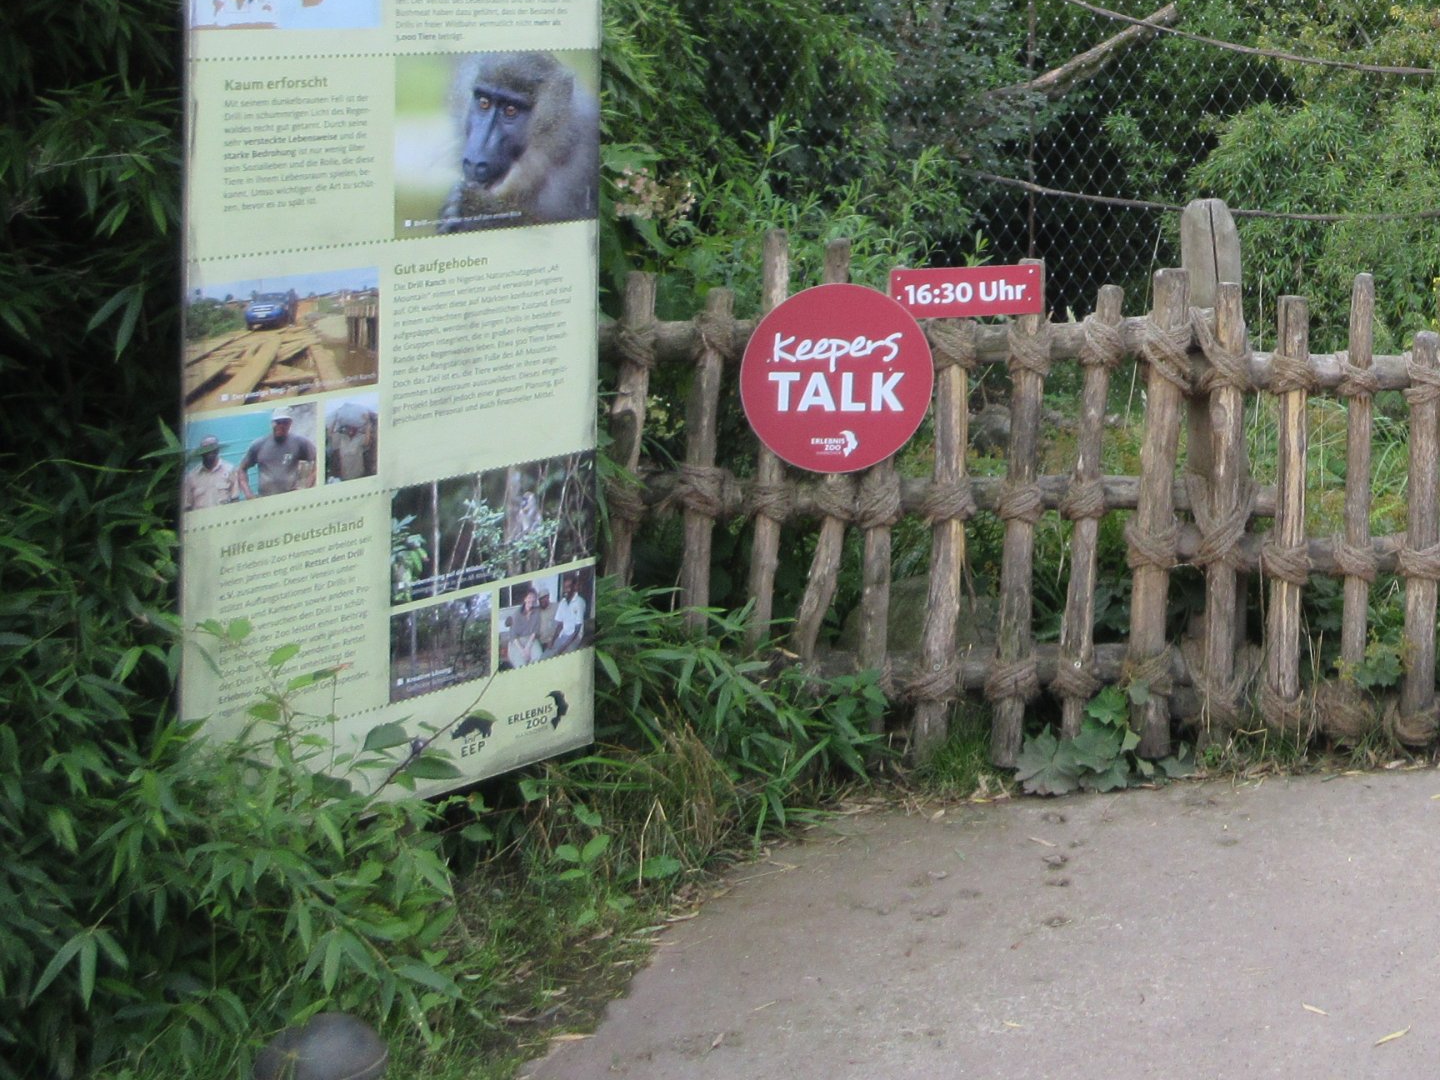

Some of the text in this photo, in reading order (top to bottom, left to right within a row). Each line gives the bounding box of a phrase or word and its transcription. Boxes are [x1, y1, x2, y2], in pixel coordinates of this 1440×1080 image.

[224, 75, 329, 91] Kaum erforscht
[288, 132, 337, 142] Lebensweise
[393, 256, 488, 276] Gut aufgehoben
[904, 279, 1027, 305] 16:30 Uhr
[772, 331, 904, 373] Keepers
[768, 371, 905, 412] TALK
[810, 437, 846, 446] ERLEBNIS
[824, 444, 842, 452] ZOO
[219, 516, 365, 559] Hilfe aus Deutschland
[506, 703, 553, 725] ERLEBNIS
[526, 716, 548, 729] ZOO
[460, 741, 486, 758] EEP
